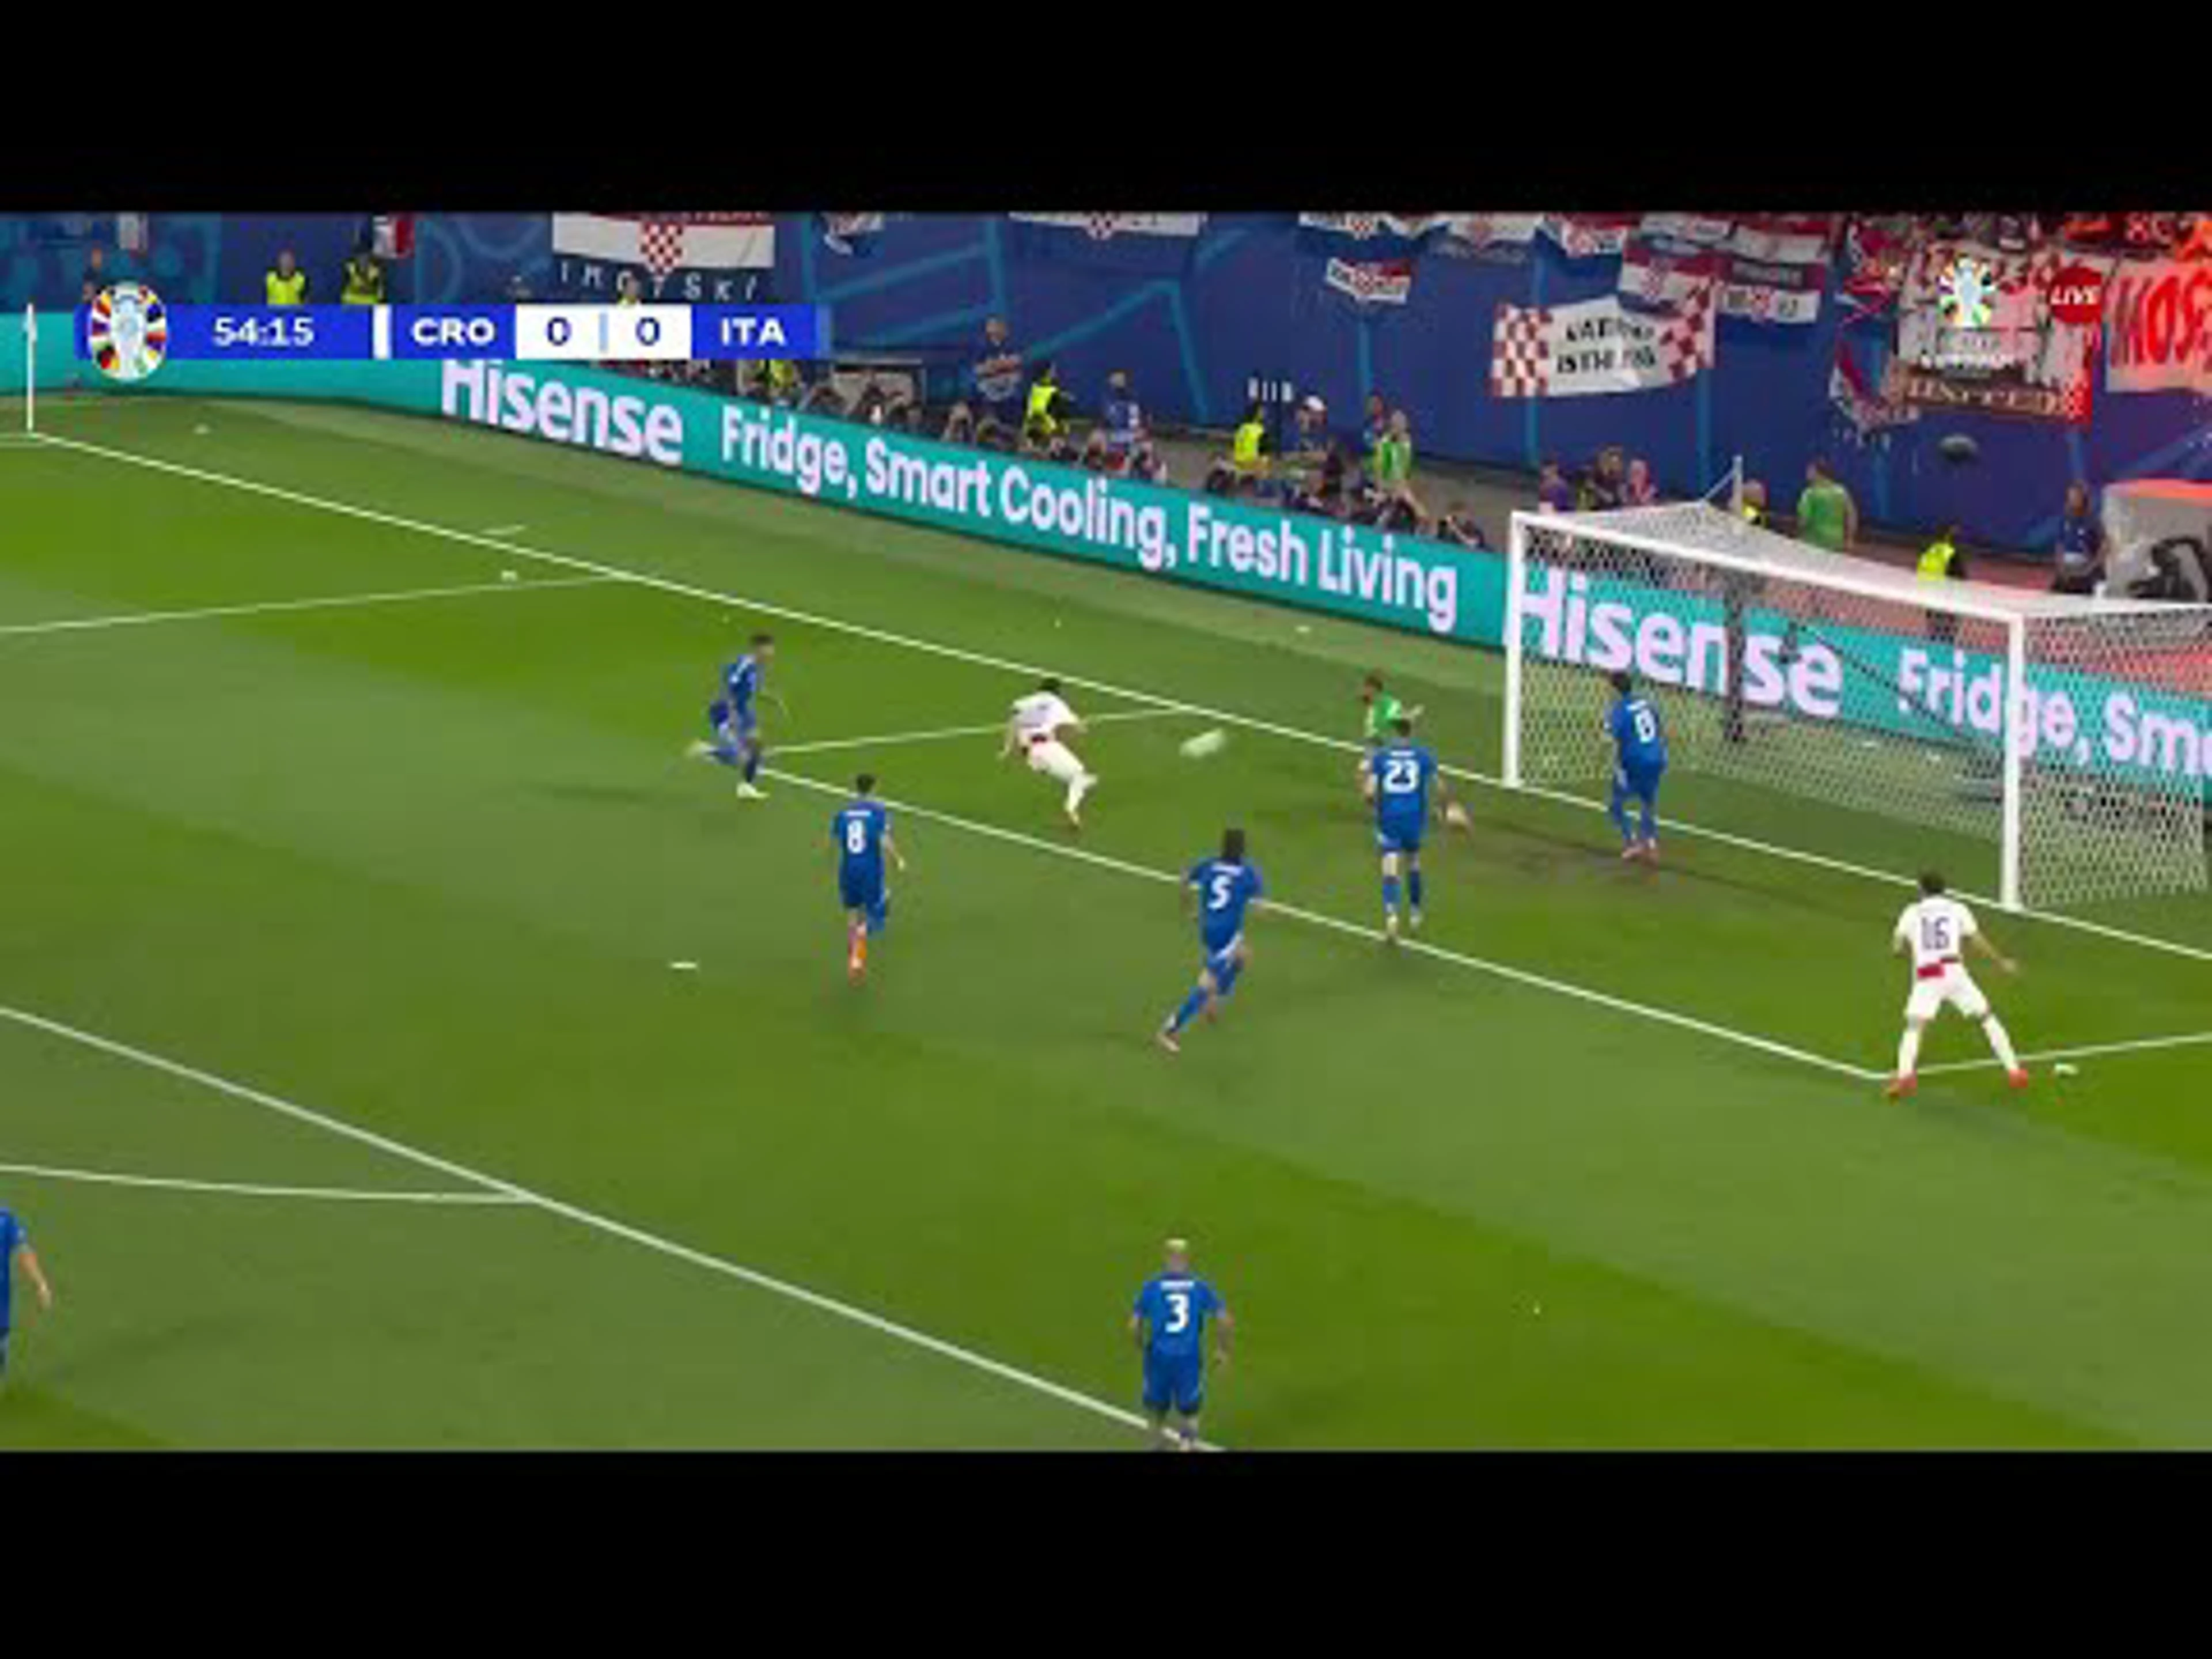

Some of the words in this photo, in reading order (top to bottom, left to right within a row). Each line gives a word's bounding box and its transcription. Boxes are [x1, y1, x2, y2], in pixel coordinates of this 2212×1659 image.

[441, 359, 683, 465] Hisense
[722, 404, 858, 497] Fridge,
[865, 437, 991, 517] Smart
[999, 467, 1177, 571] Cooling,
[1187, 501, 1307, 584] Fresh
[1317, 525, 1457, 632] Living
[1518, 559, 1842, 718] Hisense
[1382, 759, 1421, 794] 23
[847, 819, 867, 854] 8
[1207, 874, 1232, 910] 5
[1921, 916, 1950, 949] 16
[1165, 1294, 1190, 1333] 3
